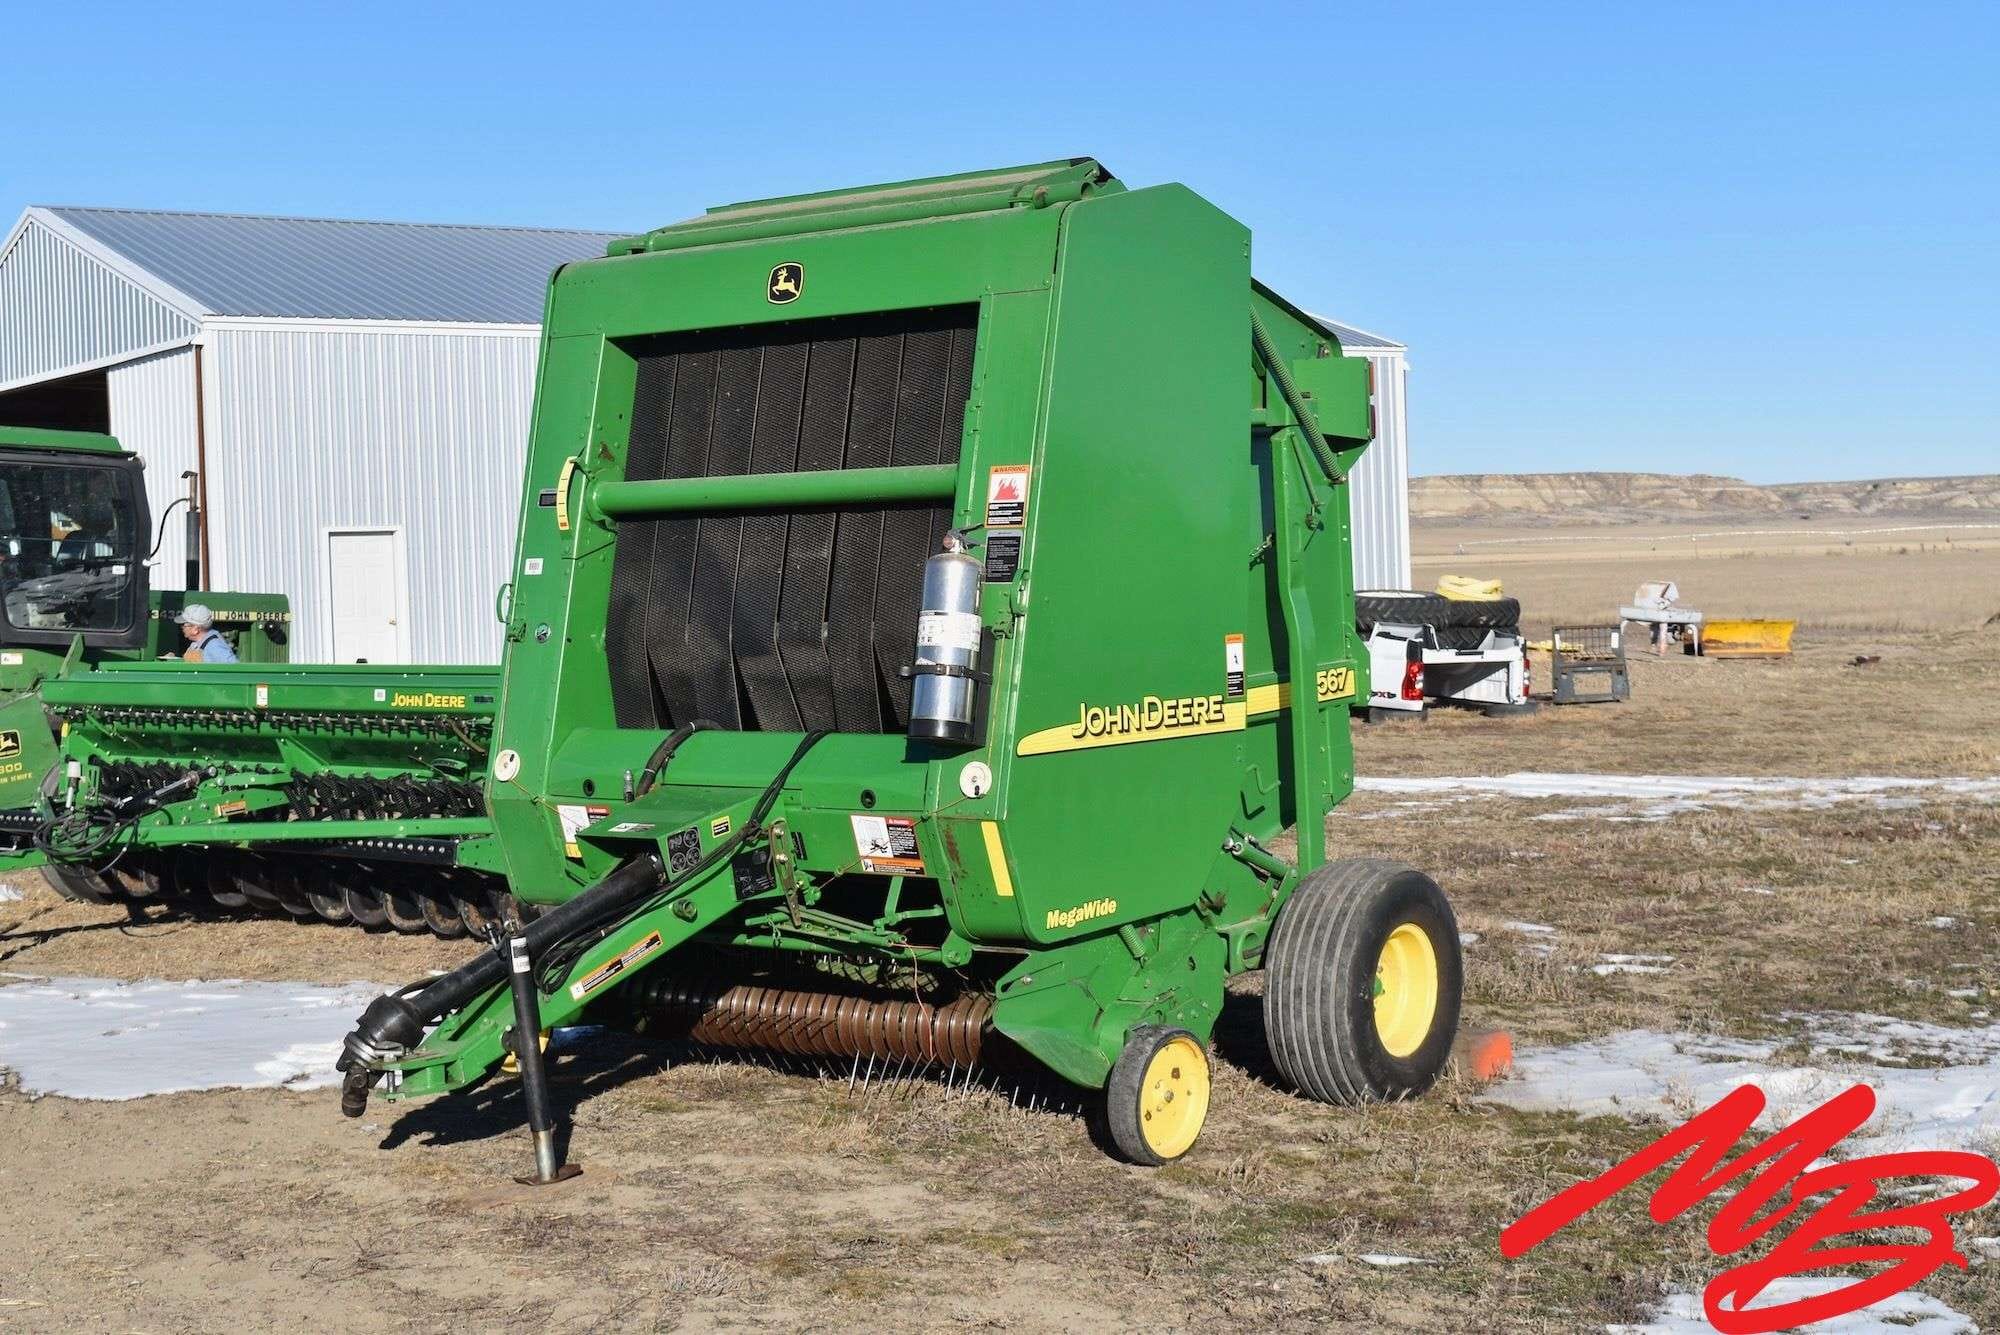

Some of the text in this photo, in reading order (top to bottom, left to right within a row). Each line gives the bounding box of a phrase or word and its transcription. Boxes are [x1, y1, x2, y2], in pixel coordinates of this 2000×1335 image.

[224, 610, 287, 622] JOHN DEERE
[1318, 666, 1348, 696] 567
[391, 692, 423, 707] JOHN
[424, 693, 466, 708] DEERE
[1072, 695, 1226, 739] JOHN DEERE
[1046, 897, 1118, 930] MegaWide
